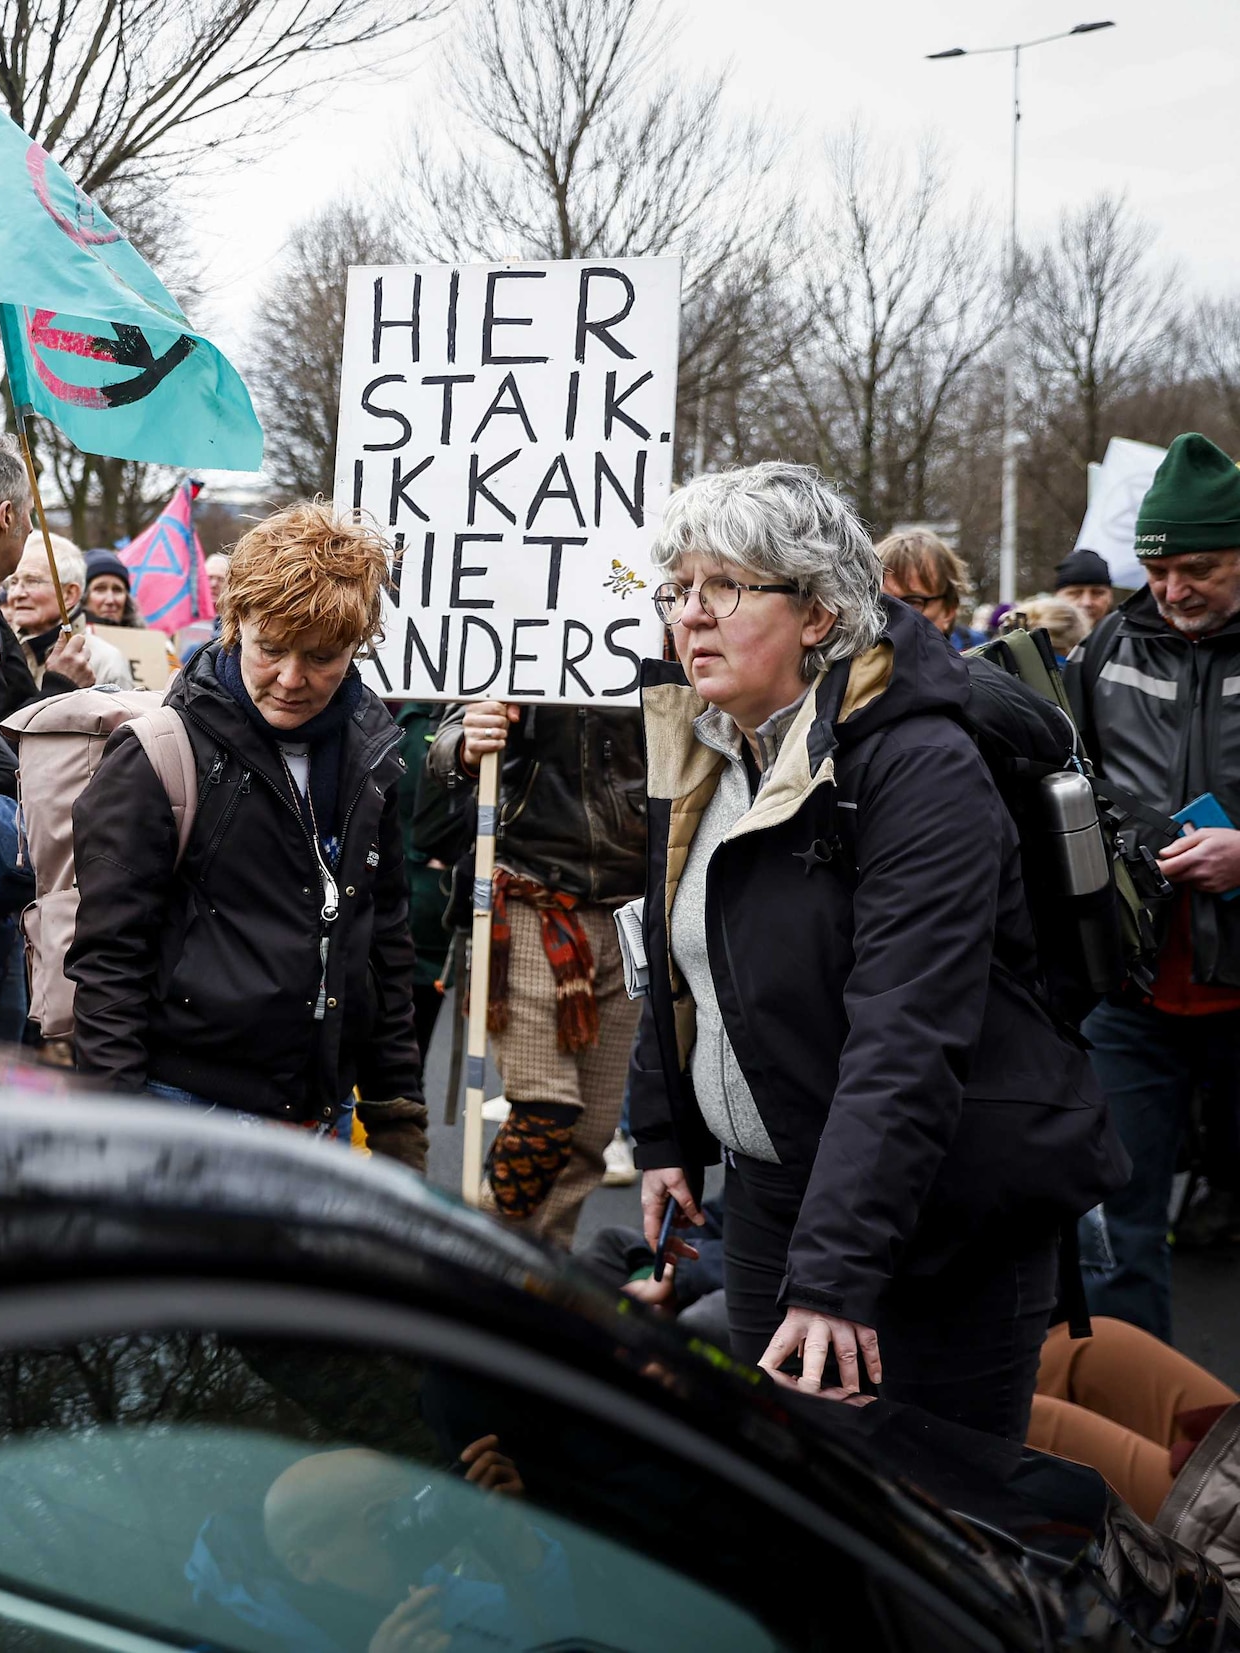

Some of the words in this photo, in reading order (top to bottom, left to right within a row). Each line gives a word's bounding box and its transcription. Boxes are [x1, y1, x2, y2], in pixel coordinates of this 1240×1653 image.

[372, 267, 638, 366] HIER
[361, 370, 538, 451] STA
[564, 370, 671, 443] IK.
[353, 454, 436, 527] IK
[466, 447, 648, 530] KAN
